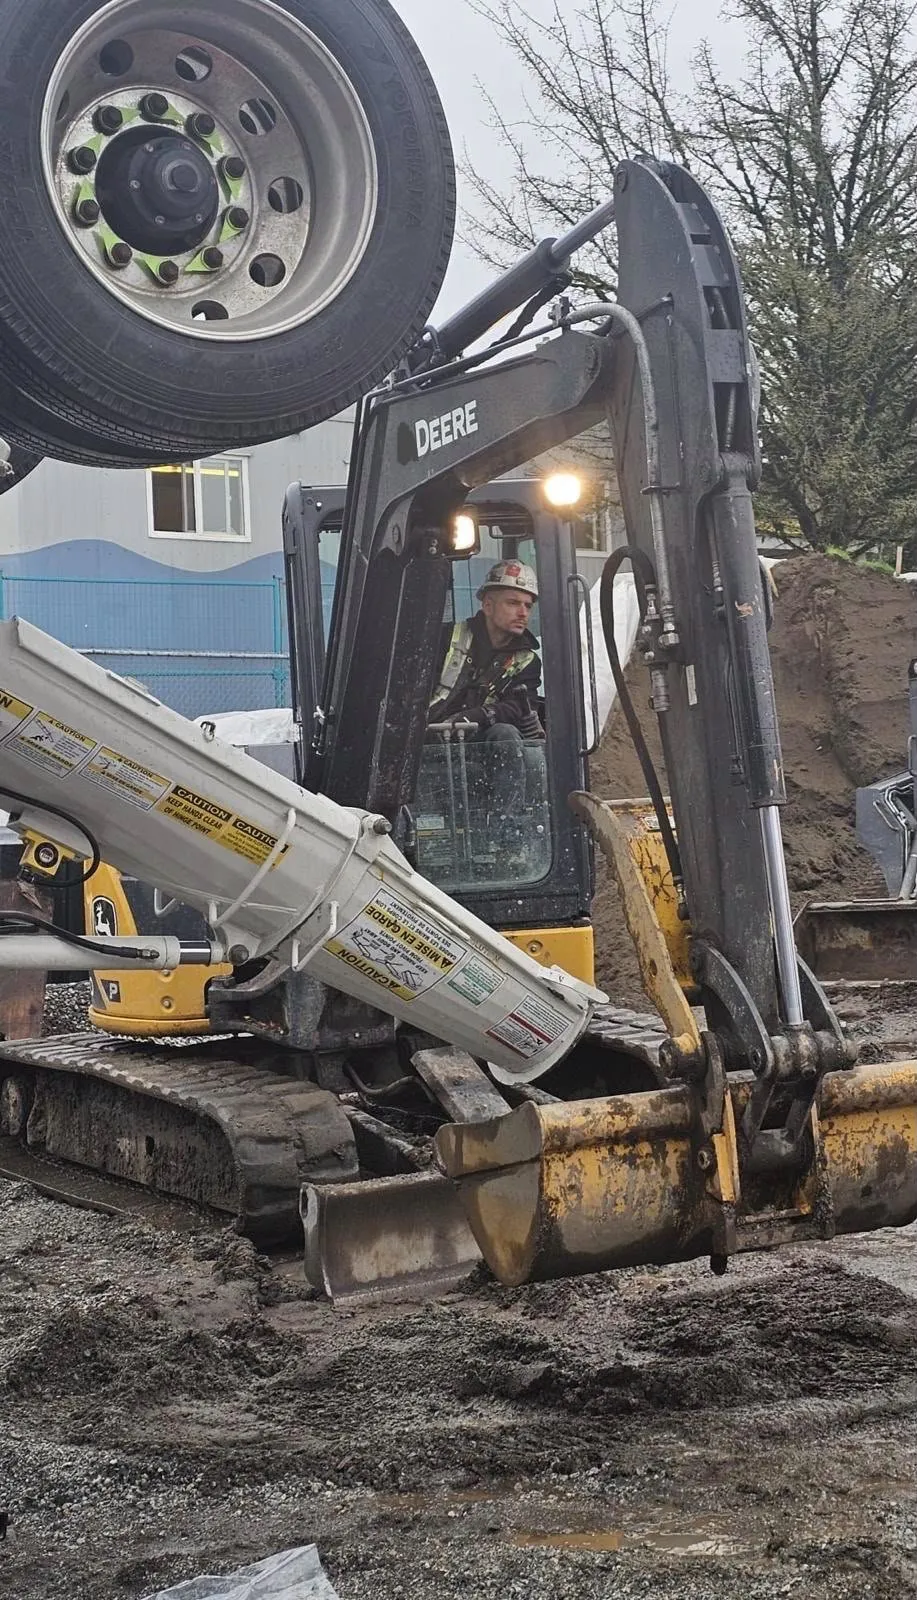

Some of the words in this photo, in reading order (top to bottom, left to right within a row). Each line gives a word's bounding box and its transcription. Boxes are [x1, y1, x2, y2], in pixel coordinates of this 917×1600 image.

[415, 400, 479, 457] DEERE
[54, 722, 85, 742] CAUTION
[123, 759, 153, 778] CAUTION
[177, 788, 228, 820] CAUTION
[166, 796, 183, 810] KEEP
[182, 802, 201, 819] HANDS
[202, 814, 222, 829] CLEAR
[164, 807, 173, 815] OF
[173, 810, 192, 825] HINGE
[191, 821, 212, 834] POINT
[236, 821, 276, 846] CAUTIO
[374, 898, 387, 909] LOIN
[365, 905, 401, 934] GARDE
[385, 906, 402, 920] CORPS
[363, 927, 377, 938] AWAY
[408, 922, 415, 930] ET
[424, 926, 442, 940] POINTS
[379, 930, 396, 943] POINTS
[400, 930, 416, 944] EN
[414, 928, 430, 940] MAINS
[389, 945, 400, 954] AND
[396, 942, 410, 953] PIVOT
[429, 938, 439, 947] LES
[441, 938, 451, 947] DES
[399, 952, 416, 965] HANDS
[409, 952, 423, 962] FROM
[414, 941, 441, 962] MISE
[438, 944, 456, 960] GARDER
[338, 948, 389, 983] CAUTION
[415, 963, 427, 973] KEEP
[109, 982, 118, 999] P
